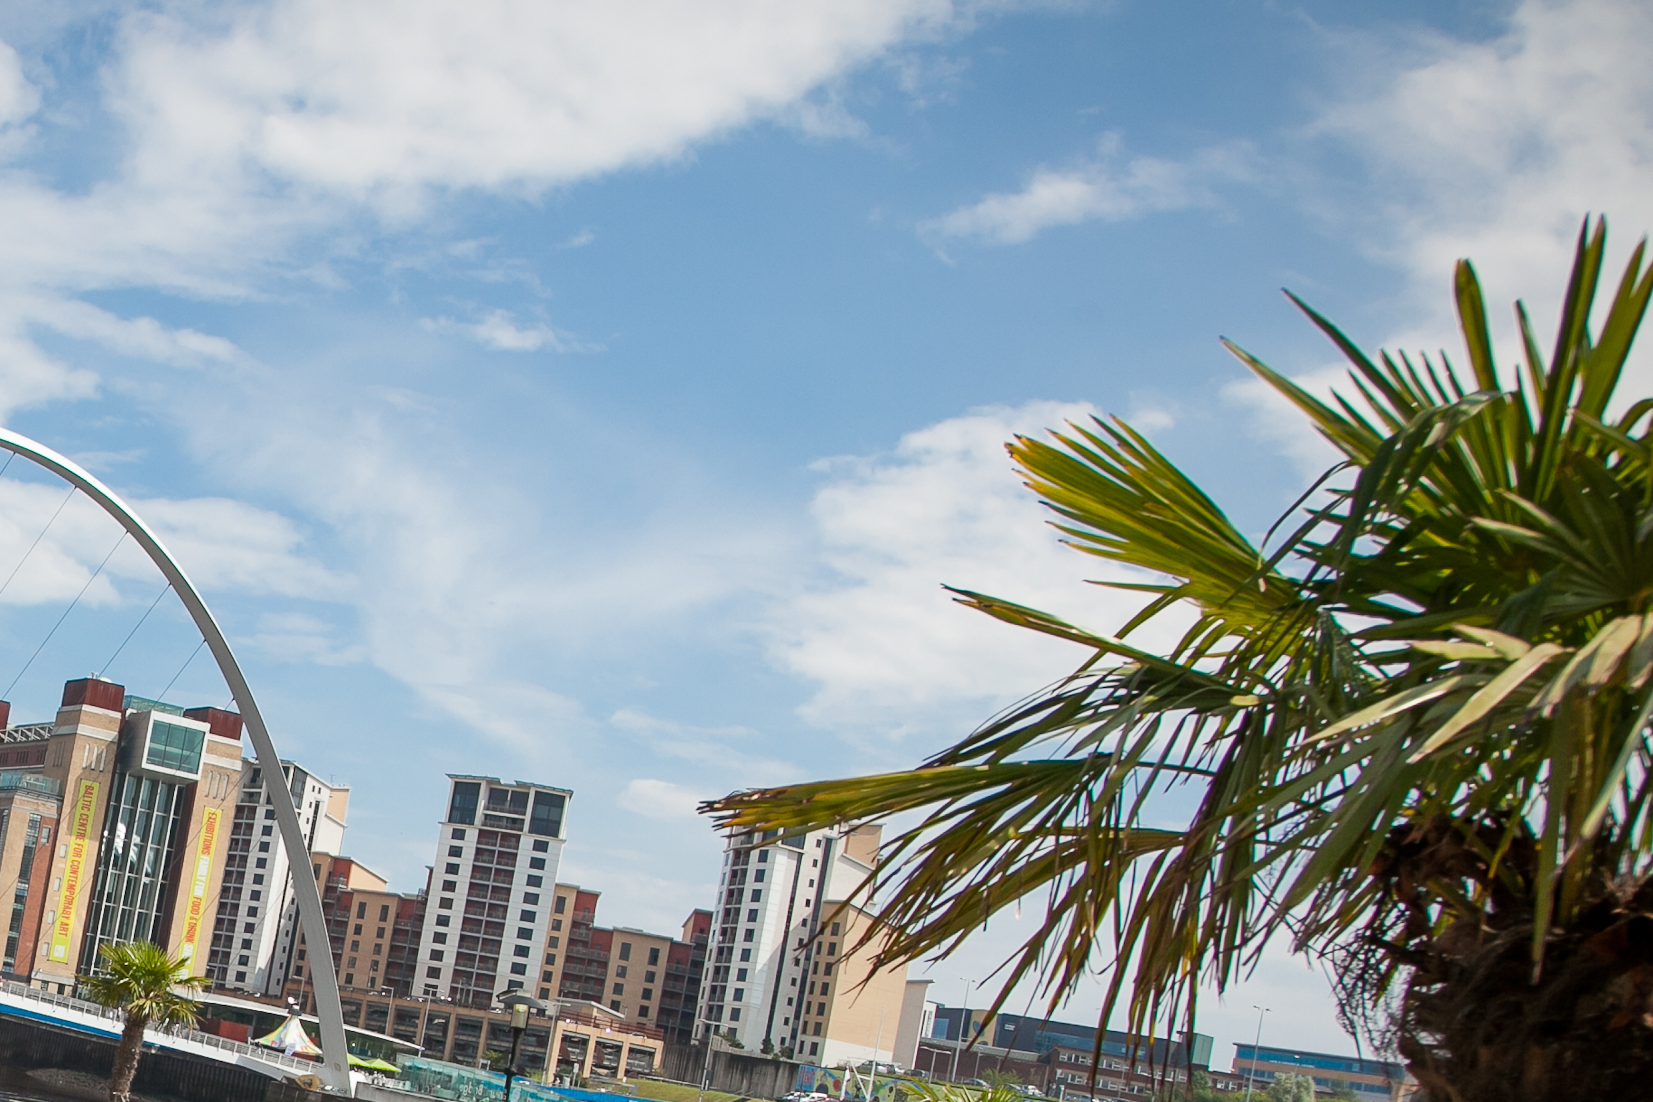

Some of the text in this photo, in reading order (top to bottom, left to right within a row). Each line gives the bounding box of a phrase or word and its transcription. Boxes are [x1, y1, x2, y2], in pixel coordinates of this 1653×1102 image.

[201, 812, 217, 855] EXHIBITIONS
[58, 784, 94, 937] BALTIC CENTRE FOR CONTEMPORARY ART
[190, 897, 202, 915] FOOD
[185, 921, 197, 944] DRINK
